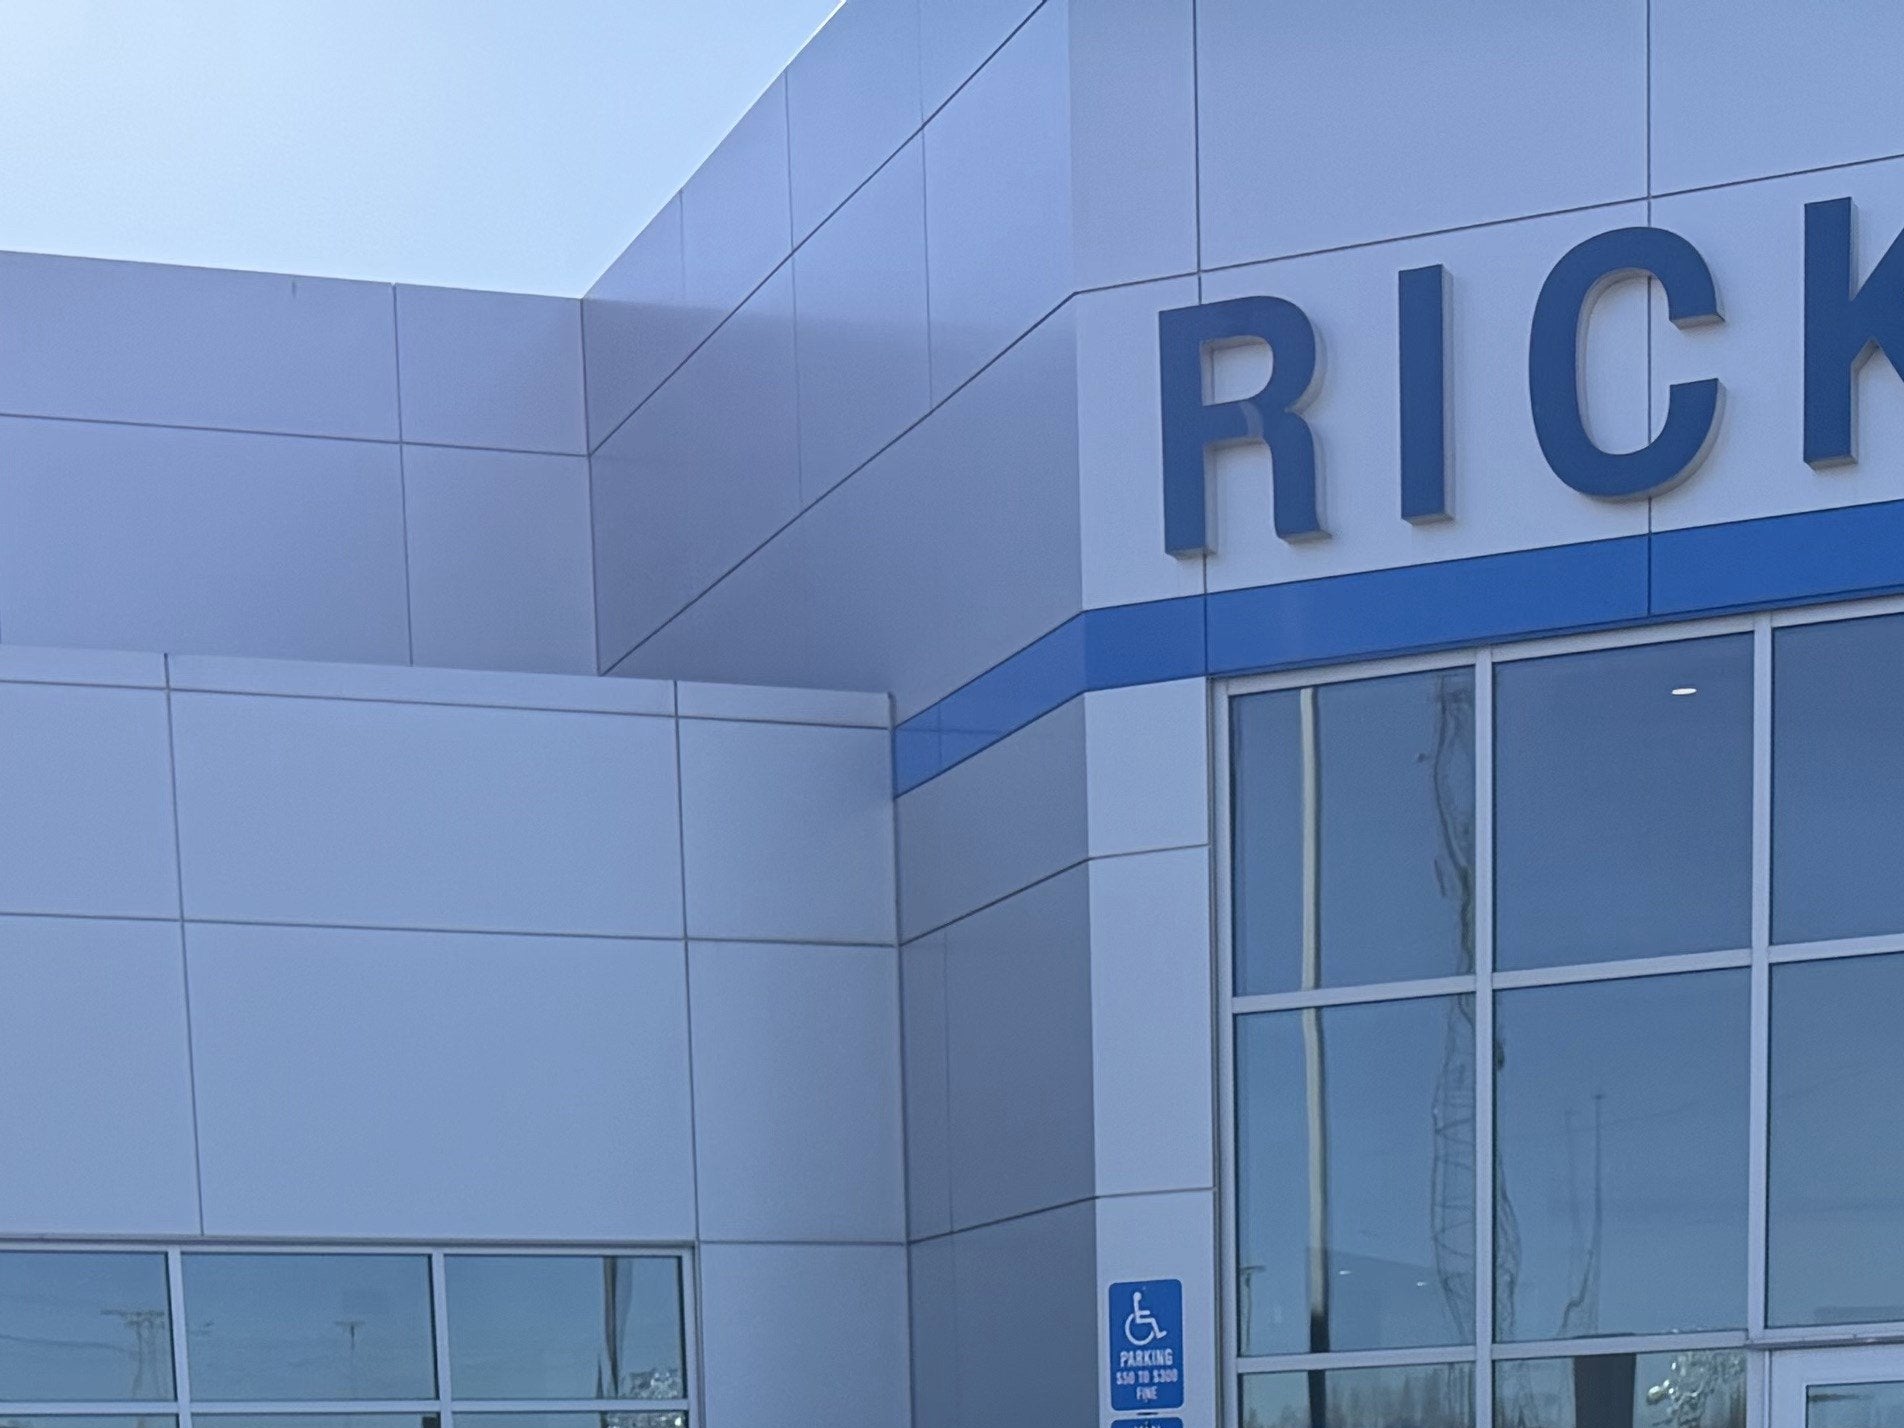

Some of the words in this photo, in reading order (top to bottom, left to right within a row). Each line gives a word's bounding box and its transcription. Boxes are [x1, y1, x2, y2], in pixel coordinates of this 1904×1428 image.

[1120, 1349, 1173, 1367] PARKING
[1138, 1371, 1150, 1383] TO
[1136, 1387, 1158, 1400] FINE
